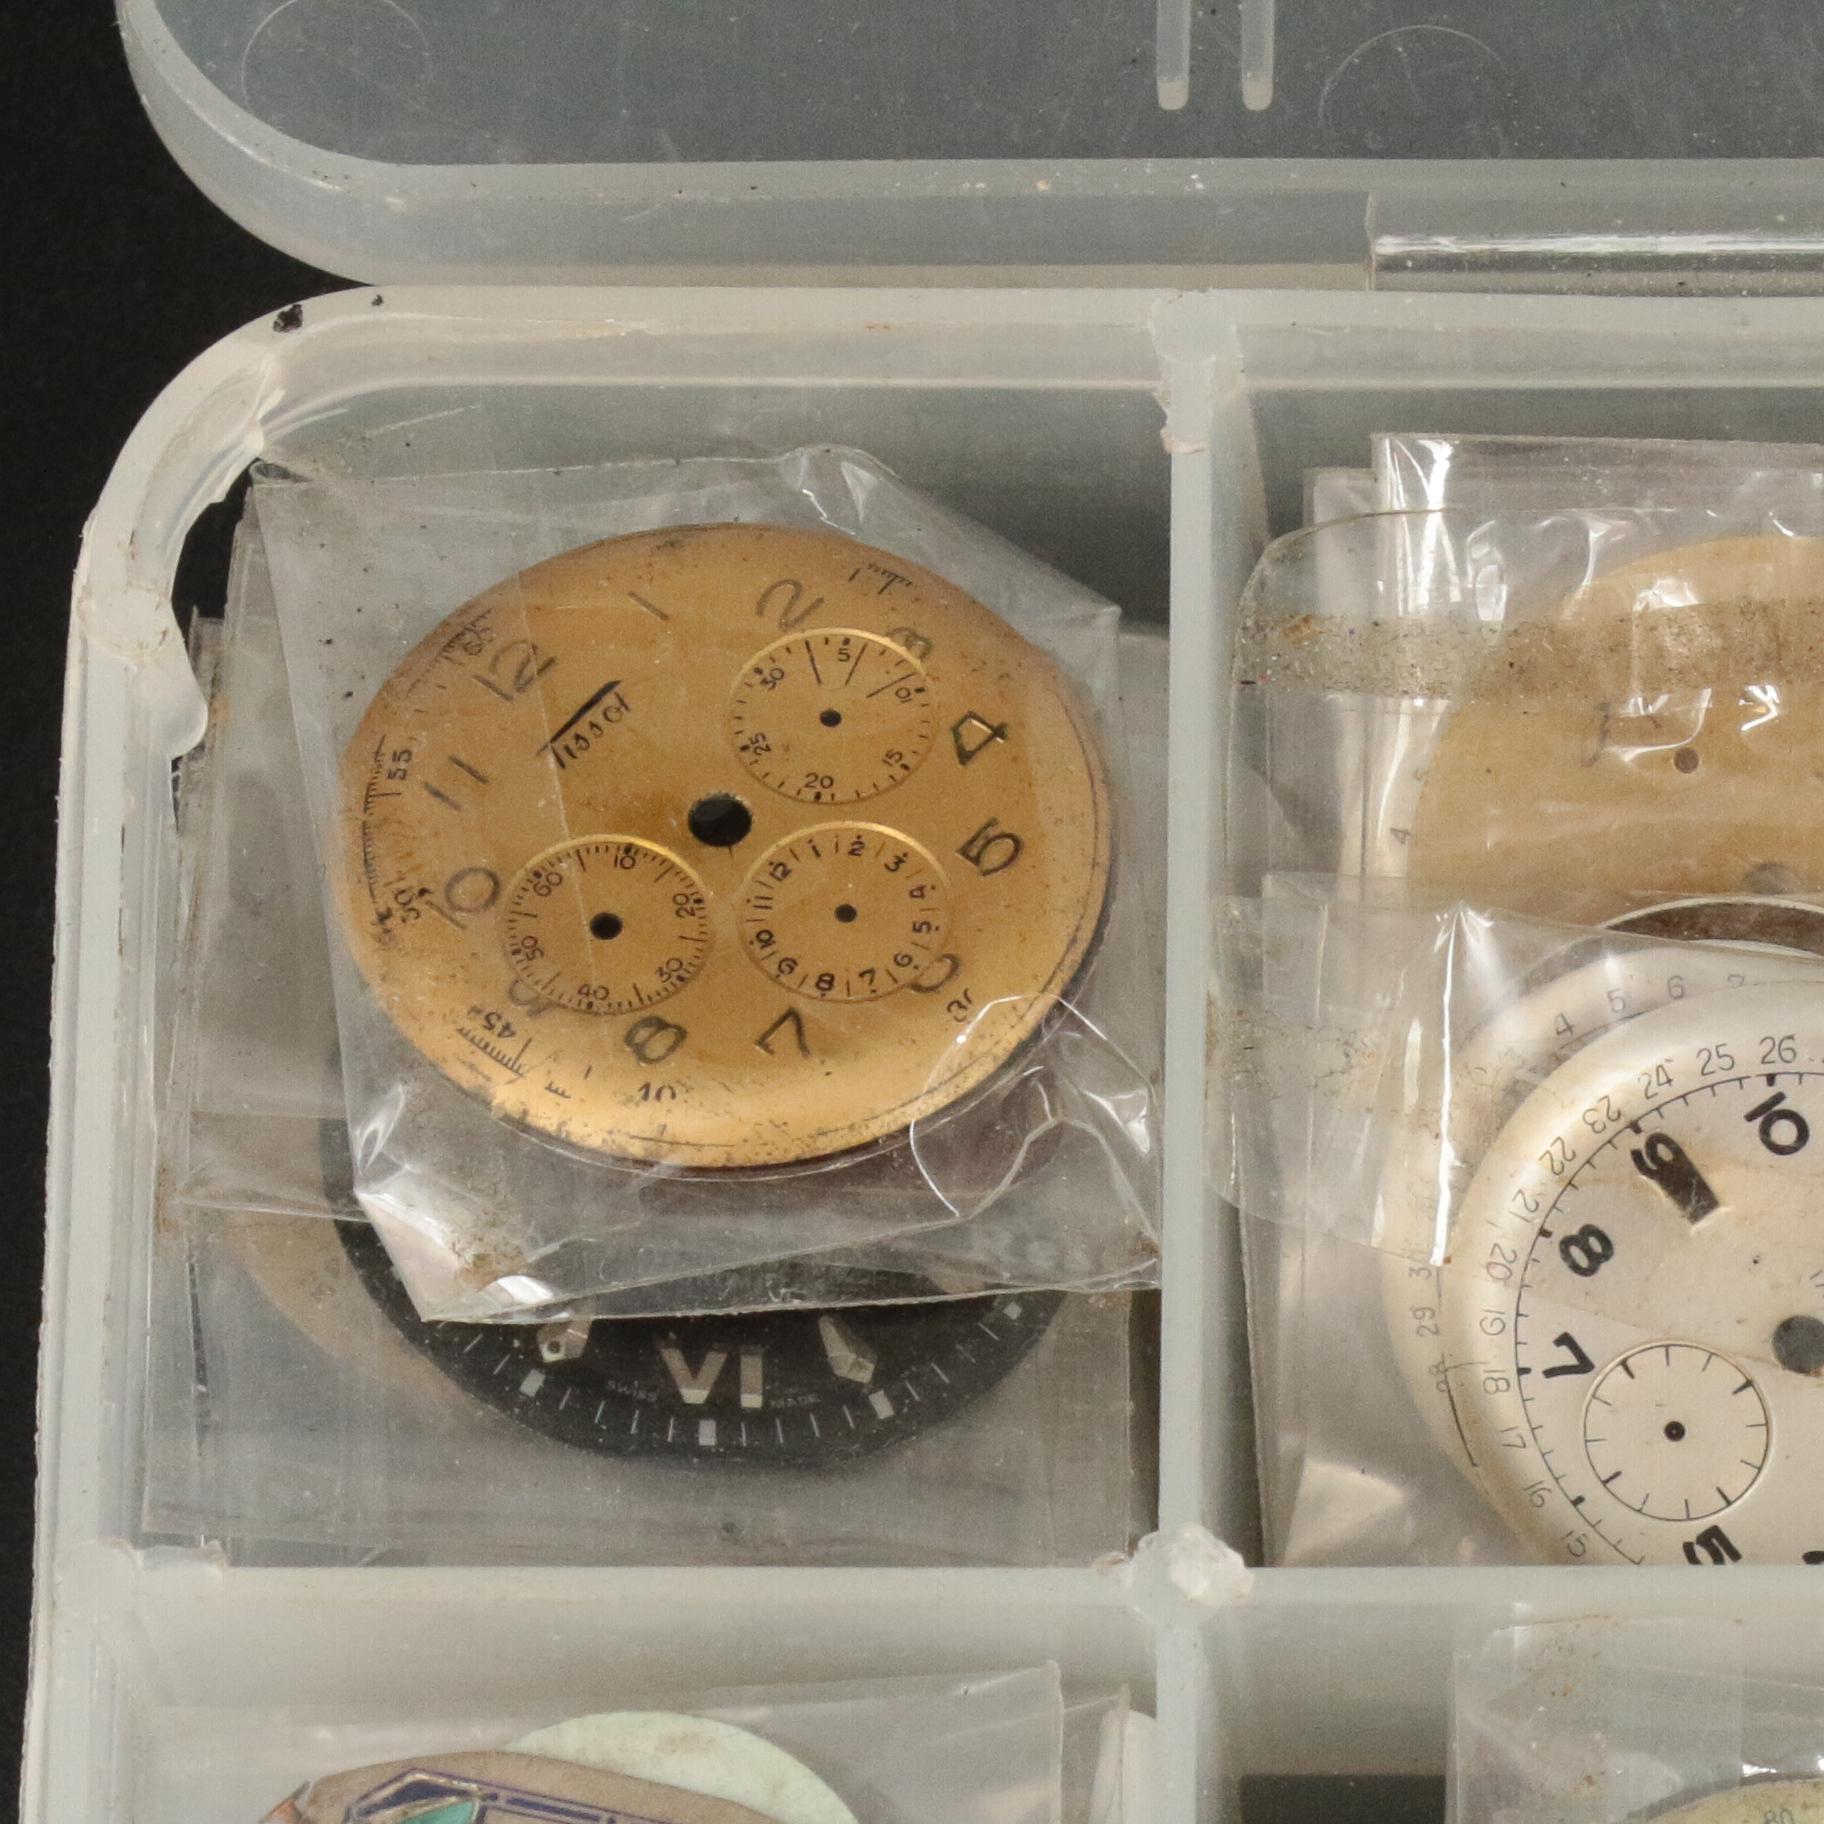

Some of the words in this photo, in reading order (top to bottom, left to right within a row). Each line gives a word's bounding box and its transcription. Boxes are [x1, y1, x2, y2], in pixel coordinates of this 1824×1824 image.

[755, 578, 824, 633] 2
[838, 648, 851, 662] 5
[471, 638, 558, 704] 12
[760, 667, 786, 691] 30
[895, 687, 913, 704] 10
[750, 732, 772, 757] 25
[951, 710, 1010, 768] 4
[387, 750, 414, 782] 55
[882, 749, 904, 768] 15
[423, 755, 490, 812] 11
[804, 773, 835, 790] 20
[849, 840, 866, 857] 2
[955, 817, 1025, 878] 5
[613, 855, 637, 870] 10
[768, 860, 793, 882] 12
[884, 855, 907, 874] 3
[532, 871, 564, 898] 60
[908, 885, 928, 900] 4
[420, 866, 502, 931] 10
[672, 893, 698, 919] 20
[752, 895, 774, 910] 11
[755, 929, 777, 949] 10
[912, 920, 933, 934] 5
[519, 935, 545, 962] 50
[893, 952, 914, 969] 6
[656, 957, 685, 984] 30
[777, 957, 799, 976] 9
[858, 968, 878, 988] 7
[576, 983, 611, 1002] 40
[815, 972, 835, 993] 8
[1667, 976, 1686, 999] 6
[1608, 989, 1627, 1013] 5
[755, 1007, 811, 1058] 7
[1555, 1013, 1575, 1038] 4
[624, 1015, 689, 1066] 8
[1758, 1035, 1798, 1066] 26
[1696, 1043, 1736, 1077] 25
[1637, 1059, 1675, 1100] 24
[1582, 1094, 1622, 1135] 23
[1743, 1091, 1811, 1157] 10
[1538, 1136, 1577, 1177] 22
[1509, 1188, 1541, 1223] 21
[1485, 1241, 1518, 1281] 20
[1558, 1223, 1615, 1278] 8
[1412, 1306, 1440, 1338] 29
[1479, 1309, 1507, 1337] 19
[1542, 1331, 1596, 1379] 7
[1482, 1368, 1512, 1394] 18
[1498, 1425, 1527, 1450] 17
[1524, 1479, 1553, 1509] 16
[1560, 1529, 1587, 1559] 15
